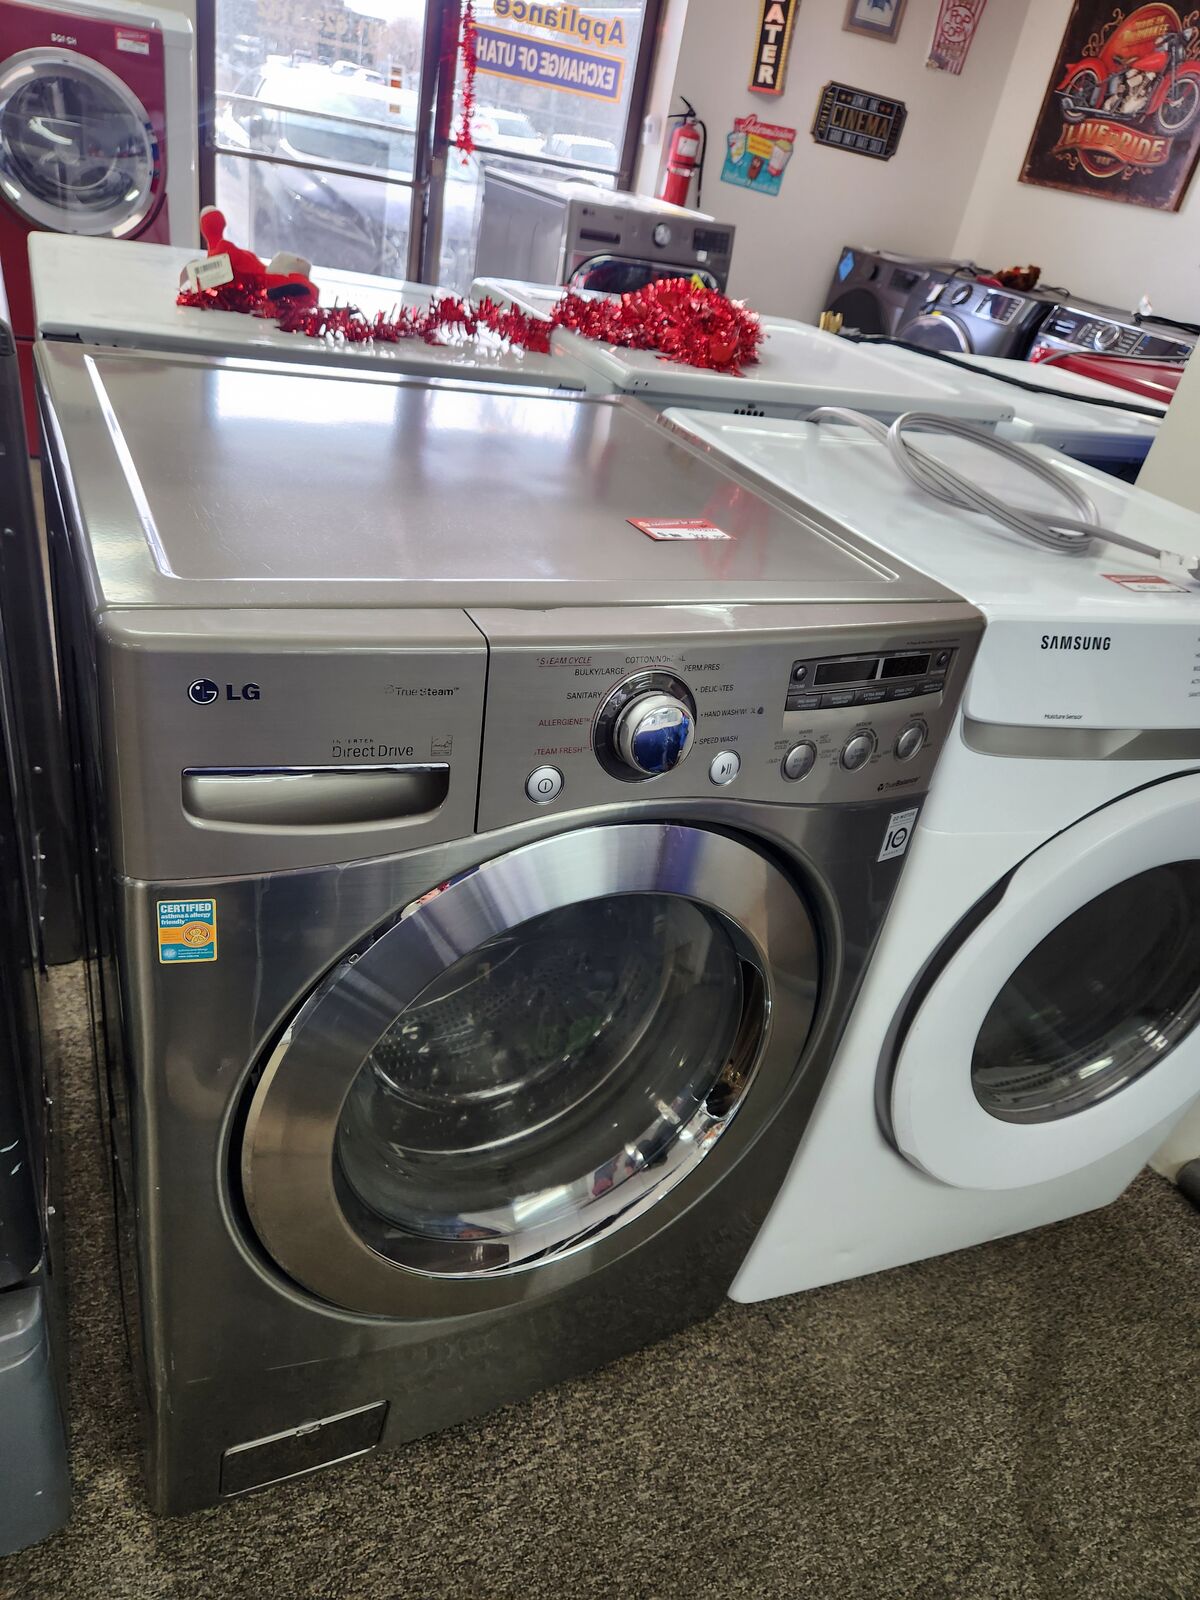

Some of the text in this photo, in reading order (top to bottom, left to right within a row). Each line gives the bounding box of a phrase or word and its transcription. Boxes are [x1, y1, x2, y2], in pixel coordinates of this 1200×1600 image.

[757, 0, 786, 84] ATER
[831, 105, 889, 138] CINEMA
[1065, 122, 1110, 146] LIVE
[1040, 635, 1111, 650] SAMSUNG
[568, 656, 592, 665] CYCLE
[574, 667, 625, 676] BULKY/LARGE
[226, 683, 260, 701] LG
[566, 691, 602, 700] SANITARY
[703, 710, 721, 718] HAND
[699, 736, 719, 745] SPEED
[332, 745, 376, 758] Direct
[378, 744, 415, 757] Drive
[885, 827, 908, 851] 10
[160, 903, 211, 913] CERTIFIED
